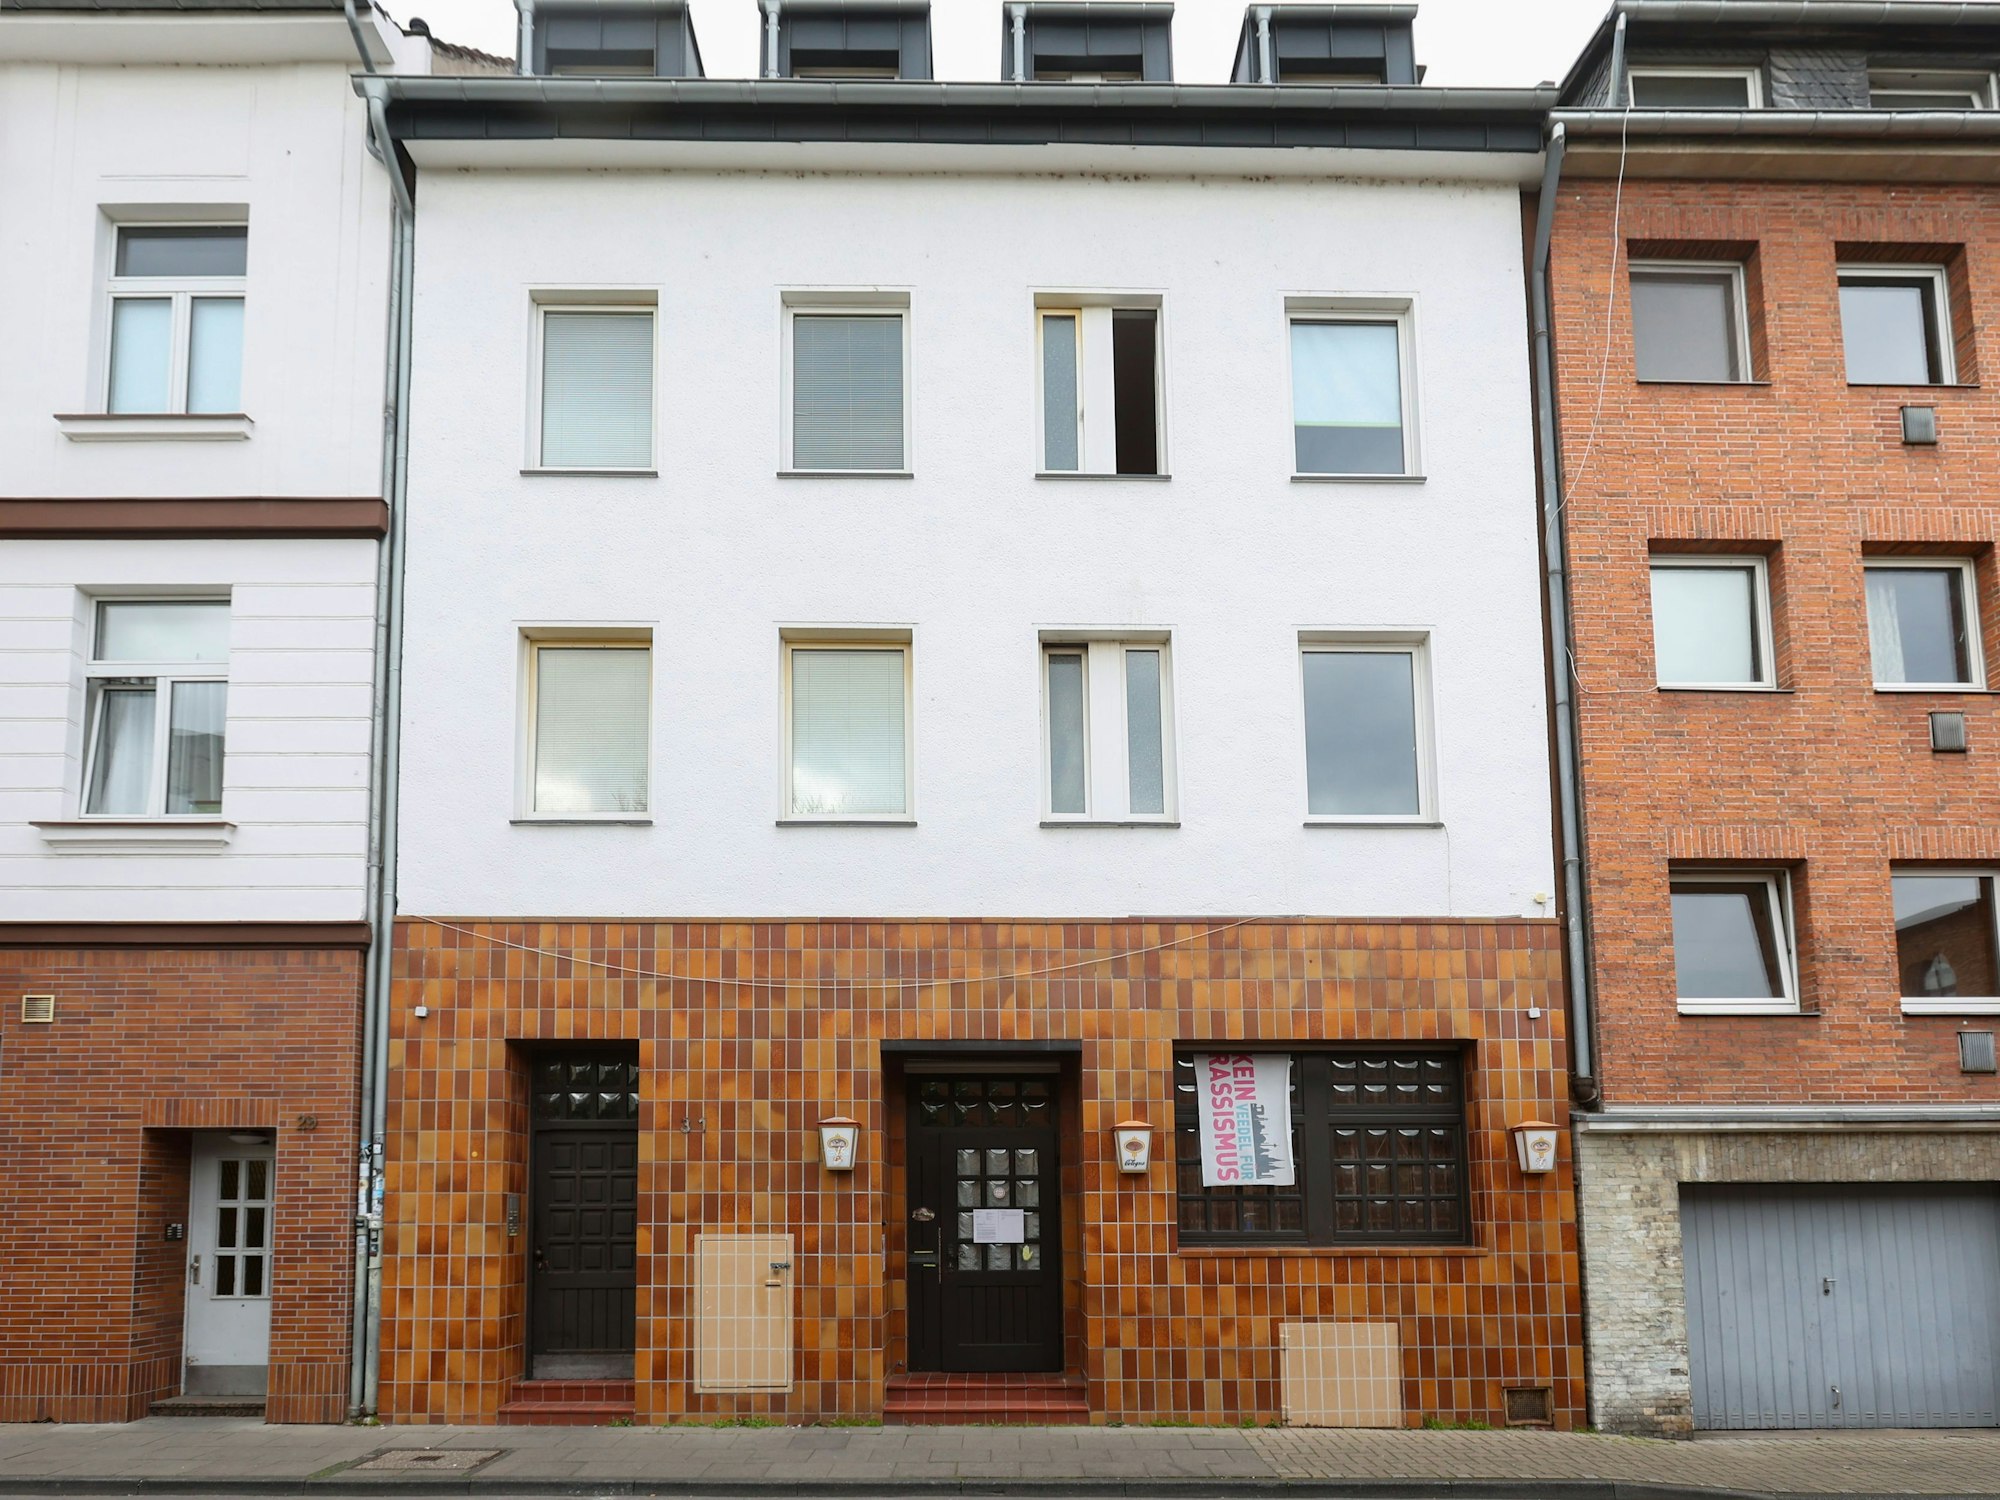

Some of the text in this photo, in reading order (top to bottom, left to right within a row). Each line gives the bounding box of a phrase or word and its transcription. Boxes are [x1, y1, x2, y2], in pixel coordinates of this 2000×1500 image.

[1231, 1053, 1257, 1101] KEIN
[1207, 1053, 1240, 1181] RASSISMUS
[1235, 1103, 1253, 1151] VEEDEL
